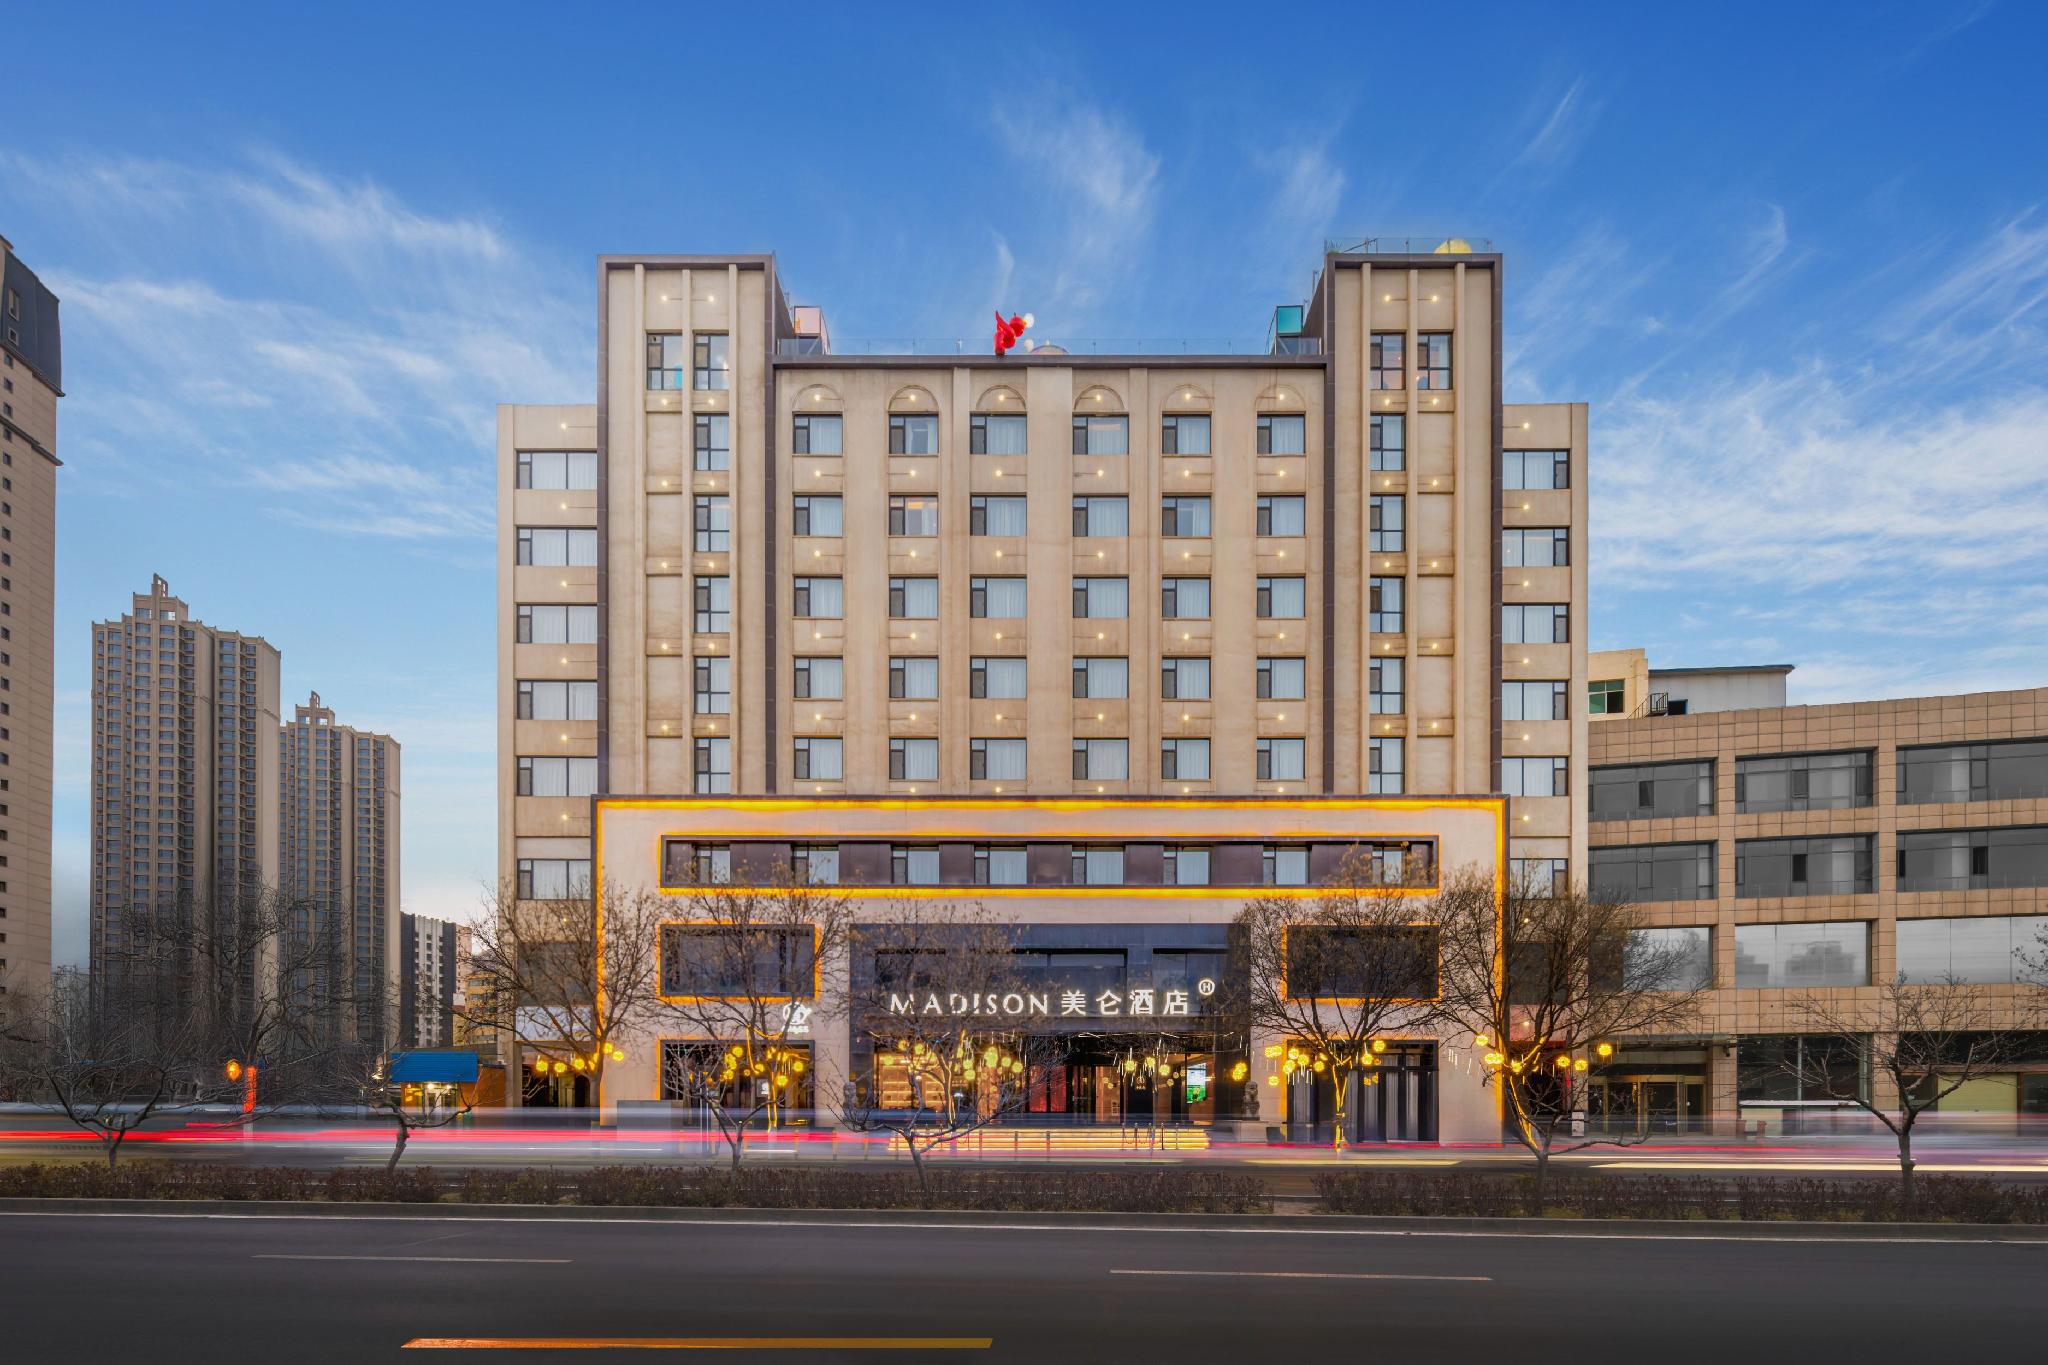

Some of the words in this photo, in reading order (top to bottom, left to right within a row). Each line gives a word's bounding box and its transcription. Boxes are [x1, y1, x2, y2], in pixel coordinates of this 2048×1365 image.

[890, 993, 1048, 1015] MADISON
[1061, 989, 1189, 1015] 美仑酒店
